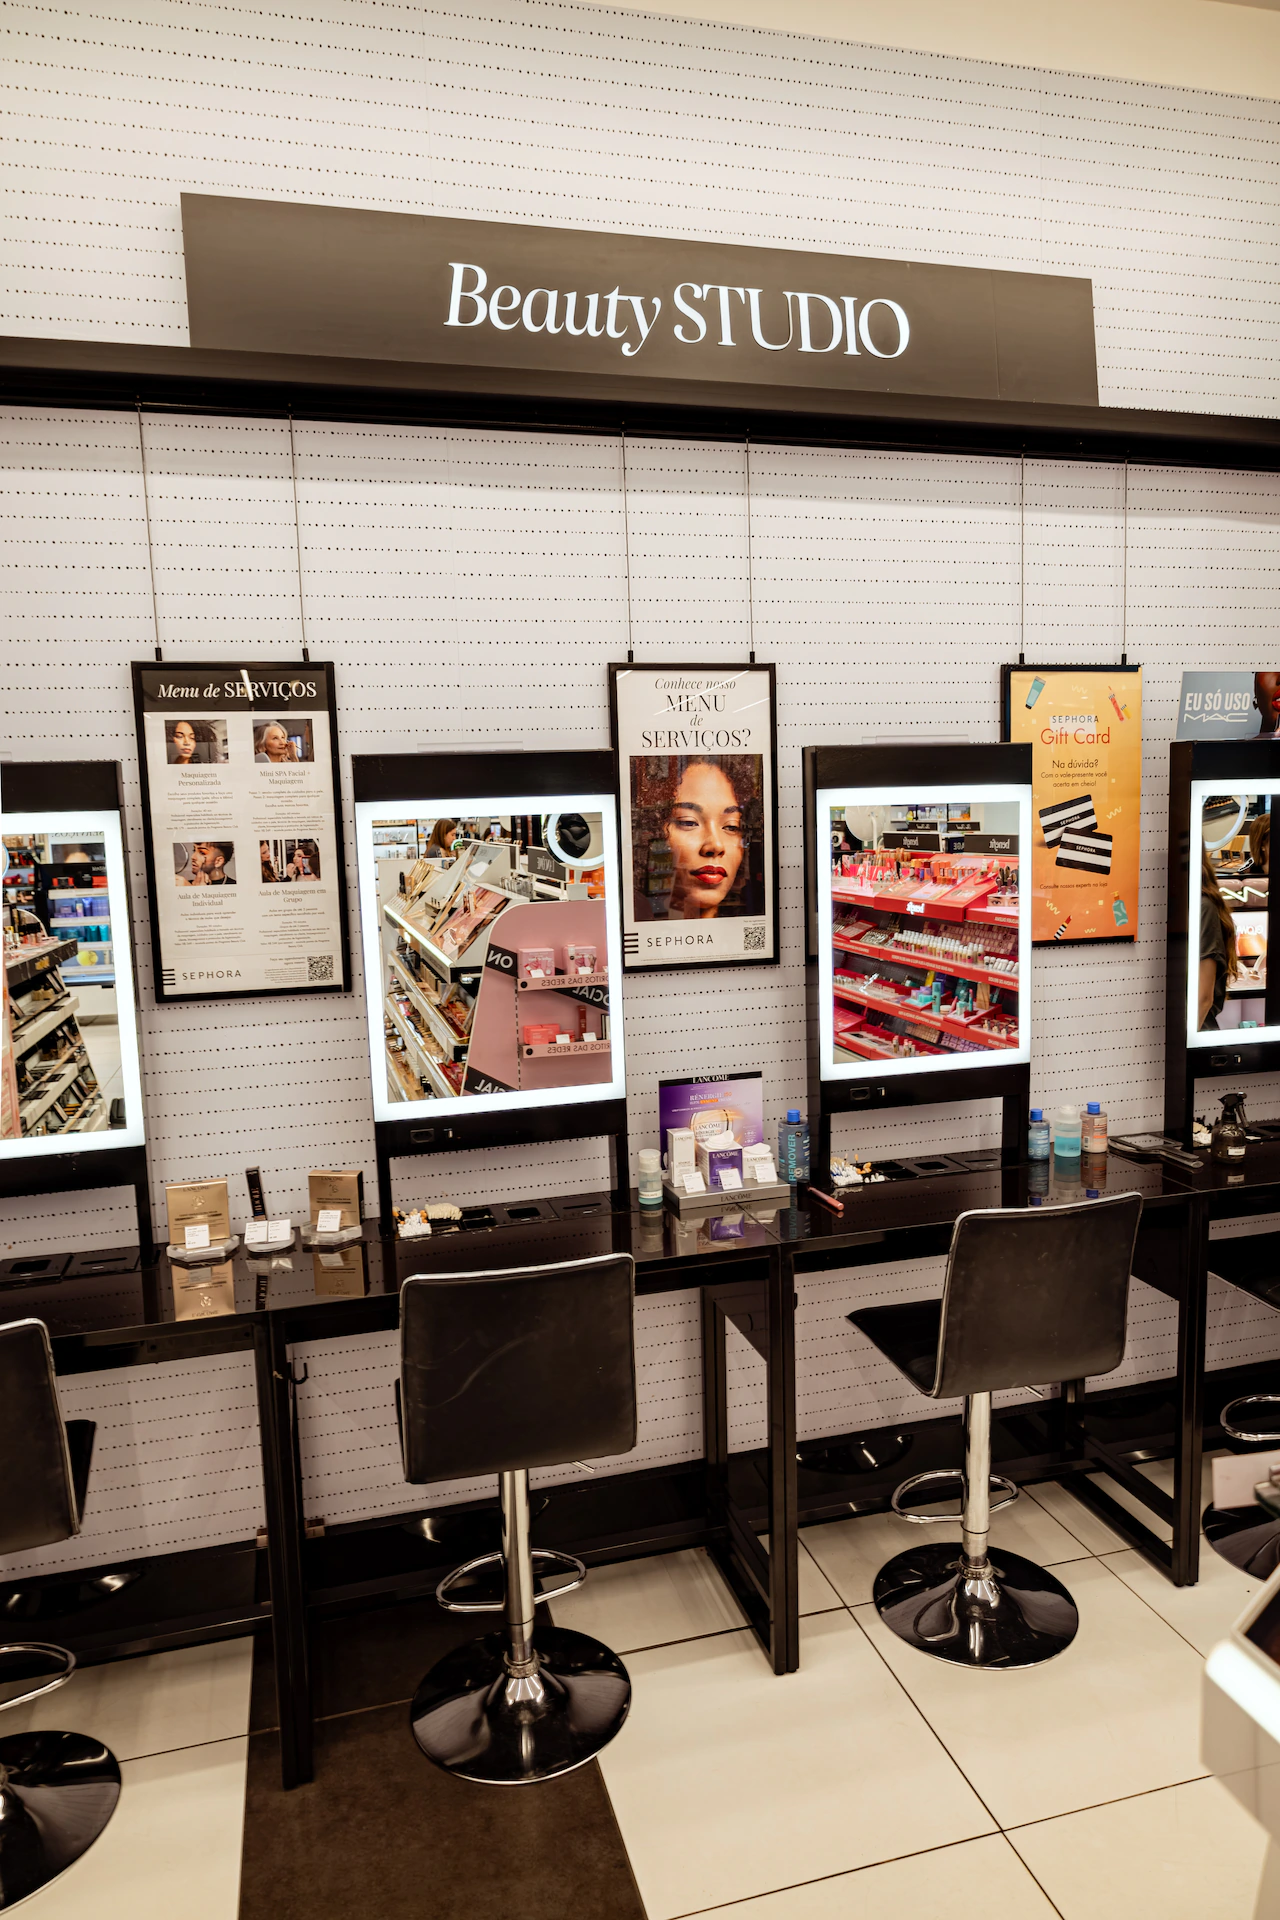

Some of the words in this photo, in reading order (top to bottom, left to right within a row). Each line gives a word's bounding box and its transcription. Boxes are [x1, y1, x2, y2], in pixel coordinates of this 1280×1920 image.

[443, 262, 662, 357] Beauty
[673, 281, 911, 359] STUDIO
[654, 677, 703, 690] Conhece
[706, 678, 736, 690] nosso
[157, 684, 200, 699] Menu
[203, 683, 221, 698] de
[224, 681, 317, 701] SERVIÇOS
[666, 694, 726, 712] MENU
[1185, 692, 1203, 711] EU
[1204, 688, 1223, 711] SÓ
[1224, 692, 1251, 711] USO
[689, 714, 704, 727] de
[1052, 715, 1099, 724] SEPHORA
[641, 727, 751, 752] SERVIÇOS?
[1040, 726, 1069, 745] Gift
[1074, 726, 1111, 745] Card
[1052, 760, 1065, 769] Na
[1068, 759, 1099, 769] dúvida?
[1060, 771, 1094, 780] vale-presente
[178, 779, 222, 787] Personalizada
[1060, 815, 1081, 826] SEPHORA
[1075, 845, 1096, 853] SEPHORA
[201, 891, 237, 899] Maquiagem
[281, 888, 316, 896] Maquiagem
[192, 899, 223, 907] Individual
[646, 934, 714, 948] SEPHORA
[182, 969, 242, 981] SEPHORA
[787, 1133, 796, 1182] REMOVER
[720, 1193, 753, 1203] LANCÔME
